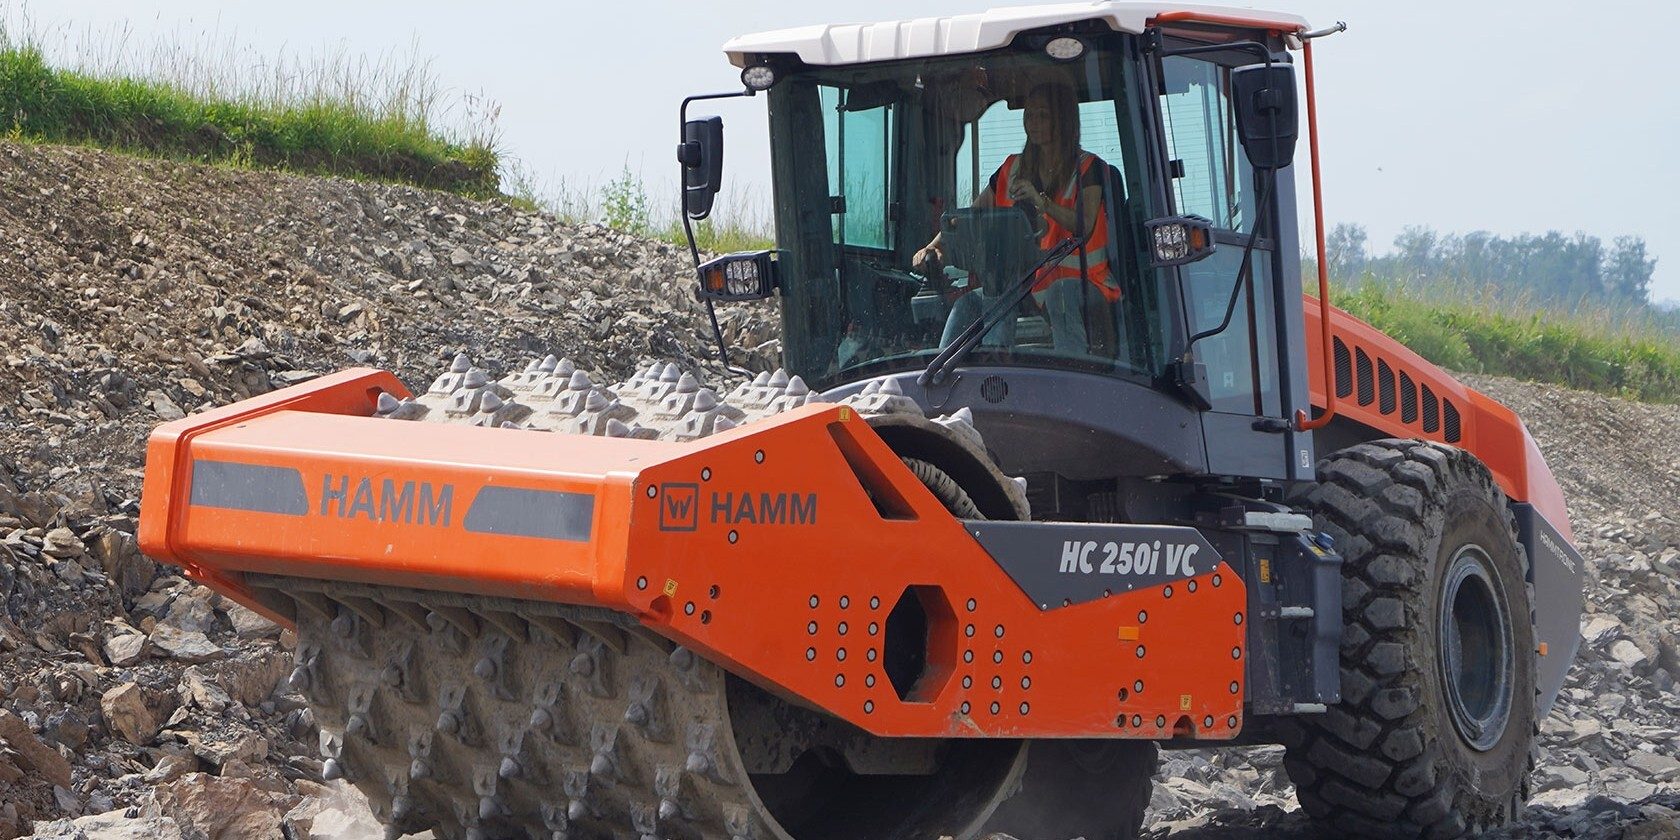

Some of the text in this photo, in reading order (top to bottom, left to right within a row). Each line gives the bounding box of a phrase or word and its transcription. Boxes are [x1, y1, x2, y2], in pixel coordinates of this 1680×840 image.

[320, 473, 453, 527] HAMM
[711, 491, 817, 525] HAMM
[1059, 540, 1200, 577] HC 250i VC
